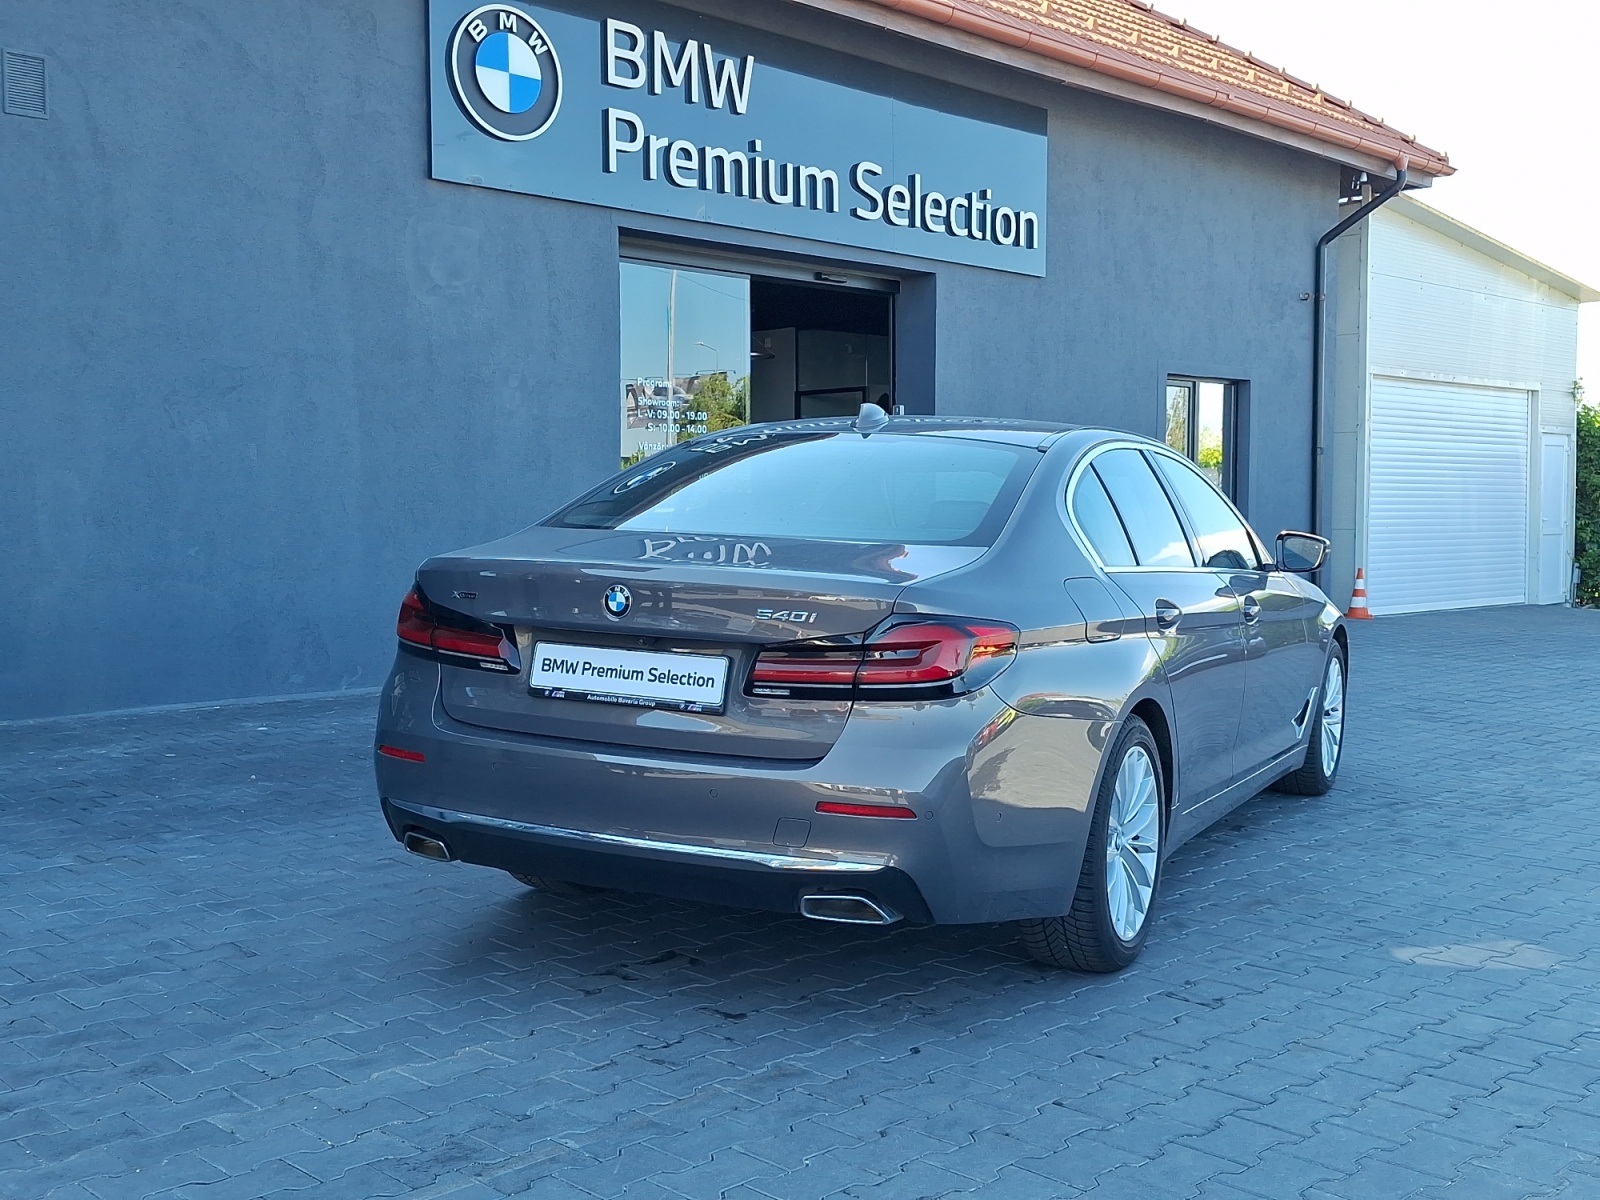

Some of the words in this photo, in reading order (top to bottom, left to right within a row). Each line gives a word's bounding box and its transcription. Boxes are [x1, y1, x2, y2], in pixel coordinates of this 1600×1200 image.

[468, 11, 548, 55] BMW
[606, 18, 754, 115] BMW
[606, 107, 839, 213] Premium
[853, 161, 1039, 249] Selection
[637, 377, 672, 389] Program:
[637, 396, 680, 407] Showroom:
[657, 410, 680, 420] 09.00
[686, 411, 708, 421] 19.00
[658, 423, 680, 433] 10.00
[686, 424, 708, 434] 14.00
[755, 608, 818, 624] 540i
[541, 657, 580, 675] BMW
[581, 661, 644, 681] Premium
[647, 667, 715, 688] Selection
[639, 699, 656, 708] Group
